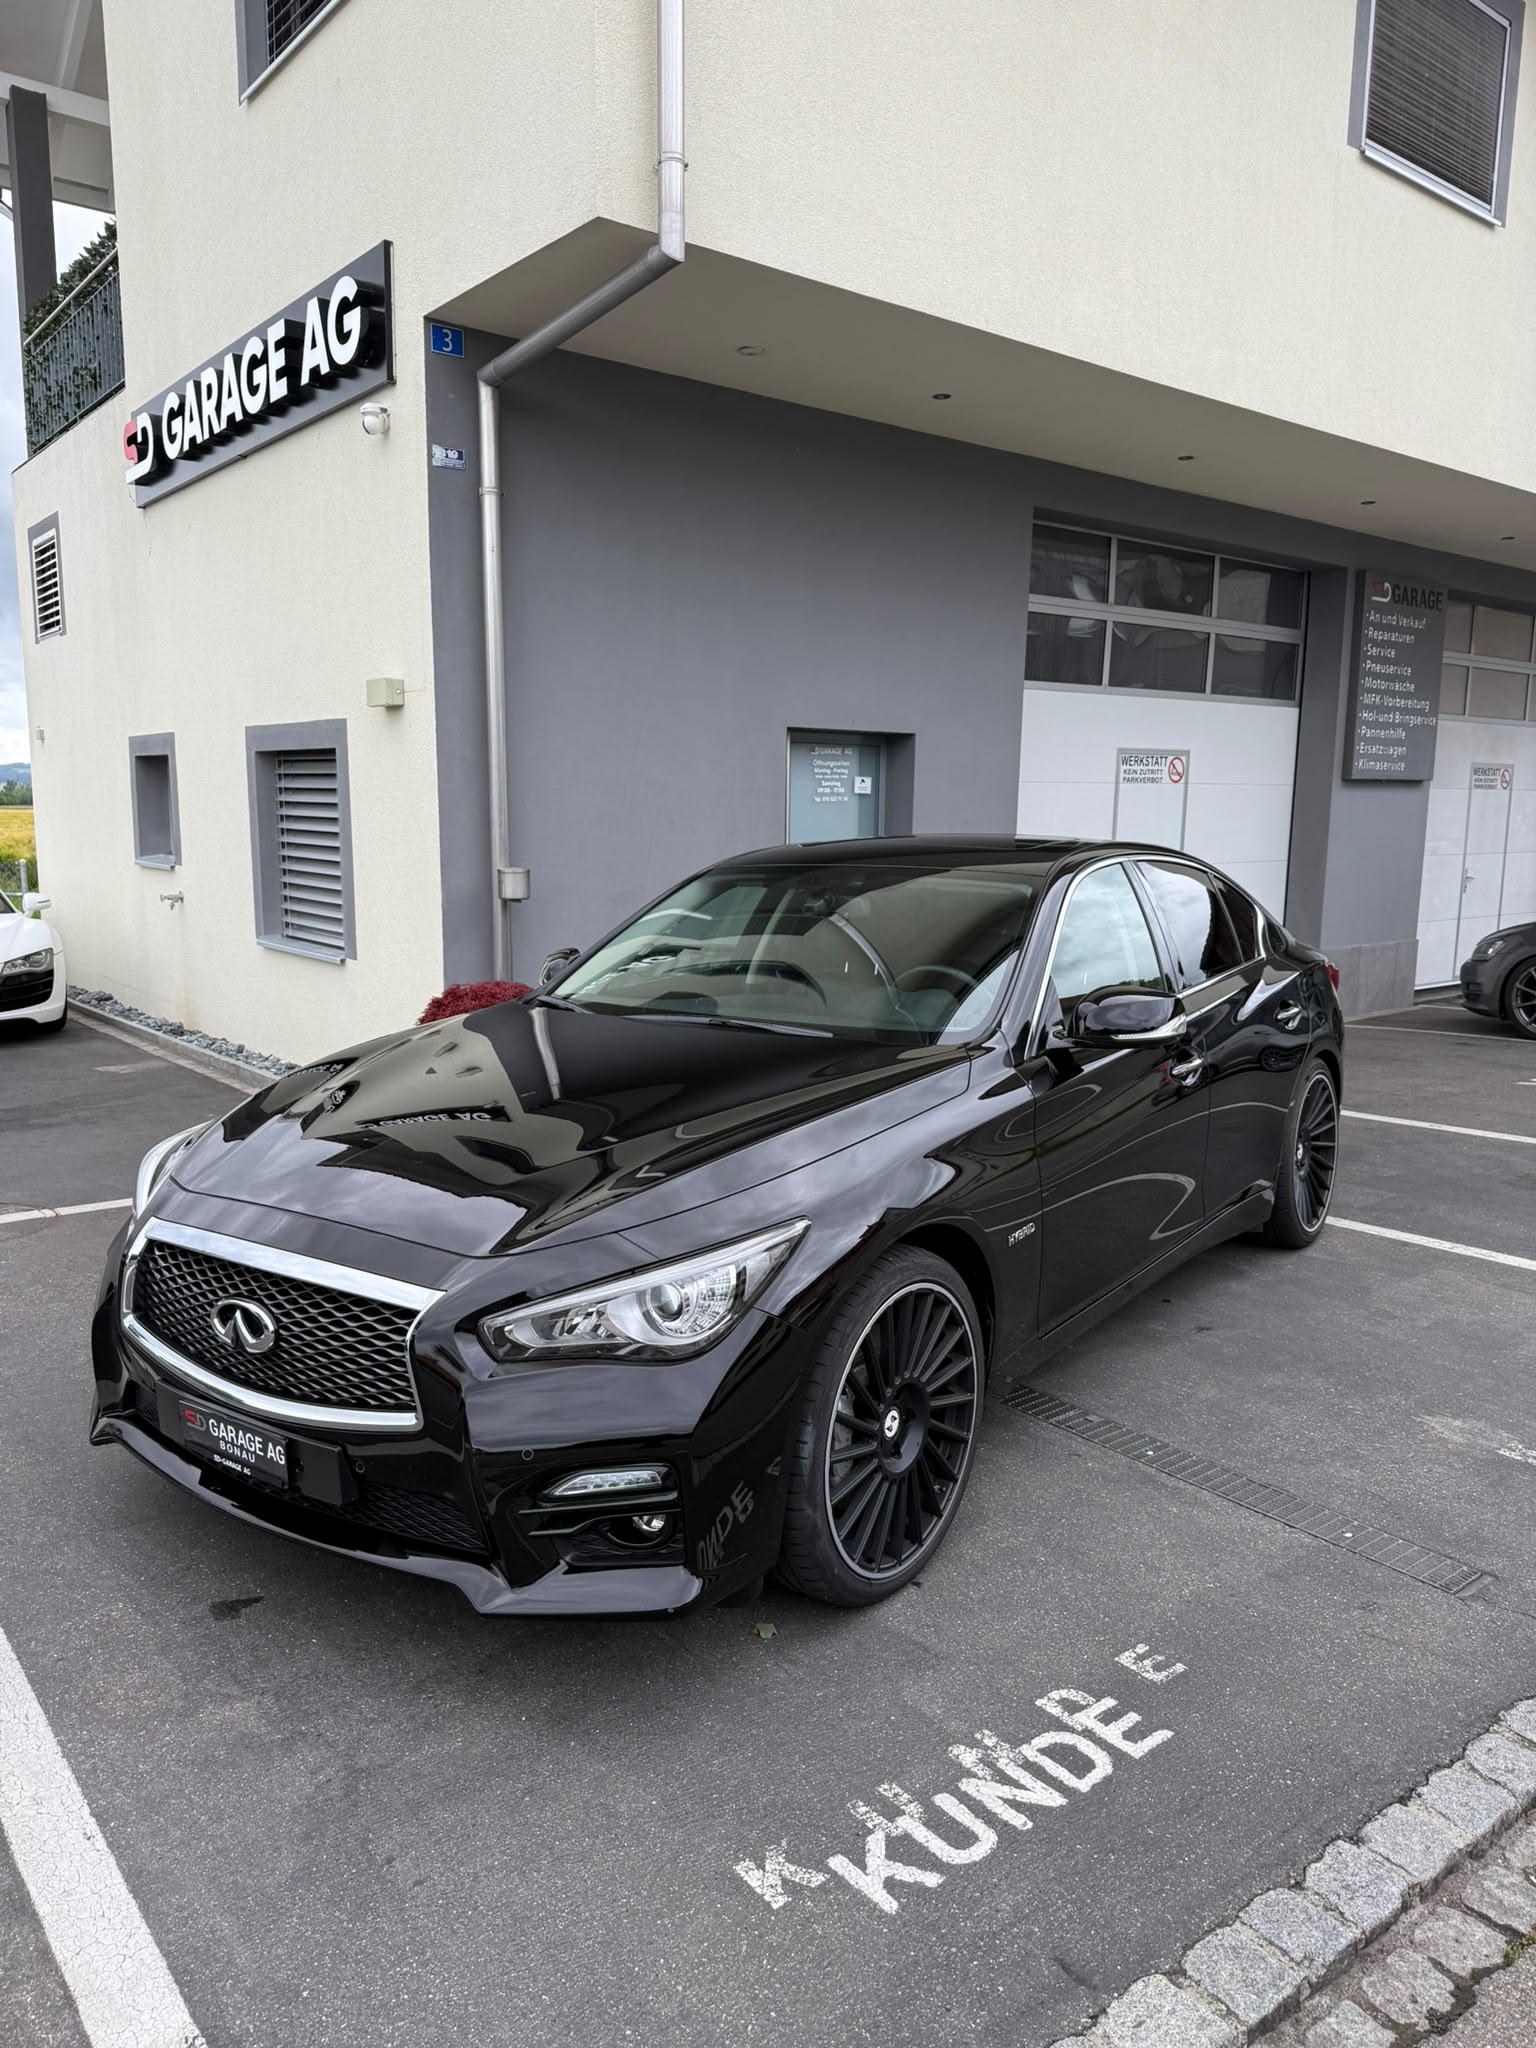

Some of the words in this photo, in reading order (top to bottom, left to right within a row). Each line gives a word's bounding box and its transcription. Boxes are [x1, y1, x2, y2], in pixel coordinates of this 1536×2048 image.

[442, 328, 453, 352] 3
[162, 318, 288, 459] GARAGE
[301, 275, 361, 387] AG
[1392, 584, 1443, 611] GARAGE
[1369, 610, 1380, 622] An
[1382, 613, 1397, 625] und
[1399, 614, 1426, 629] Verkauf
[1368, 627, 1415, 643] Reparaturen
[1367, 643, 1396, 658] Service
[1365, 660, 1412, 676] Pneuservice
[1362, 693, 1430, 712] MFK-Vorbereitung
[1395, 711, 1437, 727] Bringservice
[1361, 726, 1406, 739] Pannenhilfe
[1360, 742, 1407, 758] Ersatzwagen
[1121, 755, 1168, 767] WERKSTATT
[1358, 758, 1405, 771] Klimaservice
[1474, 768, 1501, 776] WERKSTATT
[1008, 1222, 1035, 1247] HYBRID
[209, 1418, 264, 1456] GARAGE
[267, 1441, 285, 1465] AG
[220, 1440, 255, 1463] BONAU
[826, 1696, 1175, 1915] KUNDE
